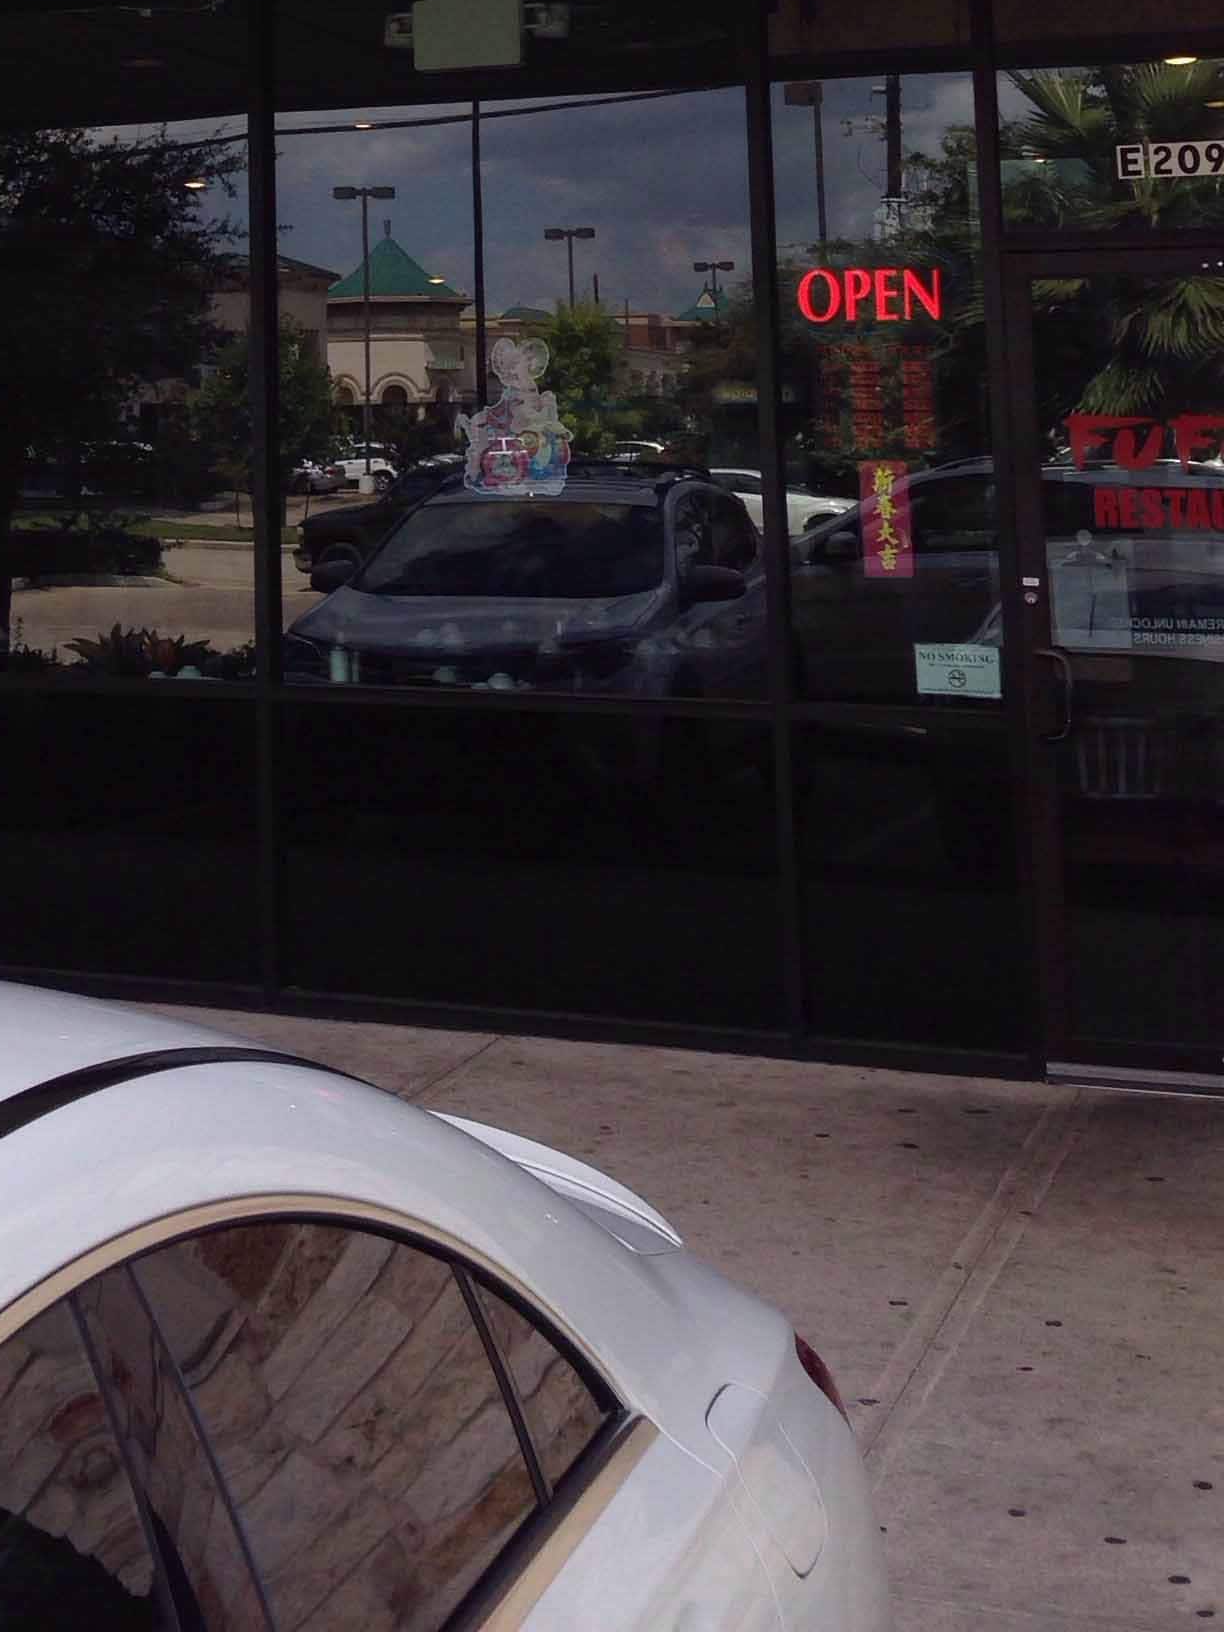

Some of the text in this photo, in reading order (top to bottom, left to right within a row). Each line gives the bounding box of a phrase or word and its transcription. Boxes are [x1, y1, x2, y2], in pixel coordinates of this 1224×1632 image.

[797, 266, 944, 323] OPEN
[872, 464, 900, 571] 新春大吉
[919, 650, 995, 665] NO SMOKING
